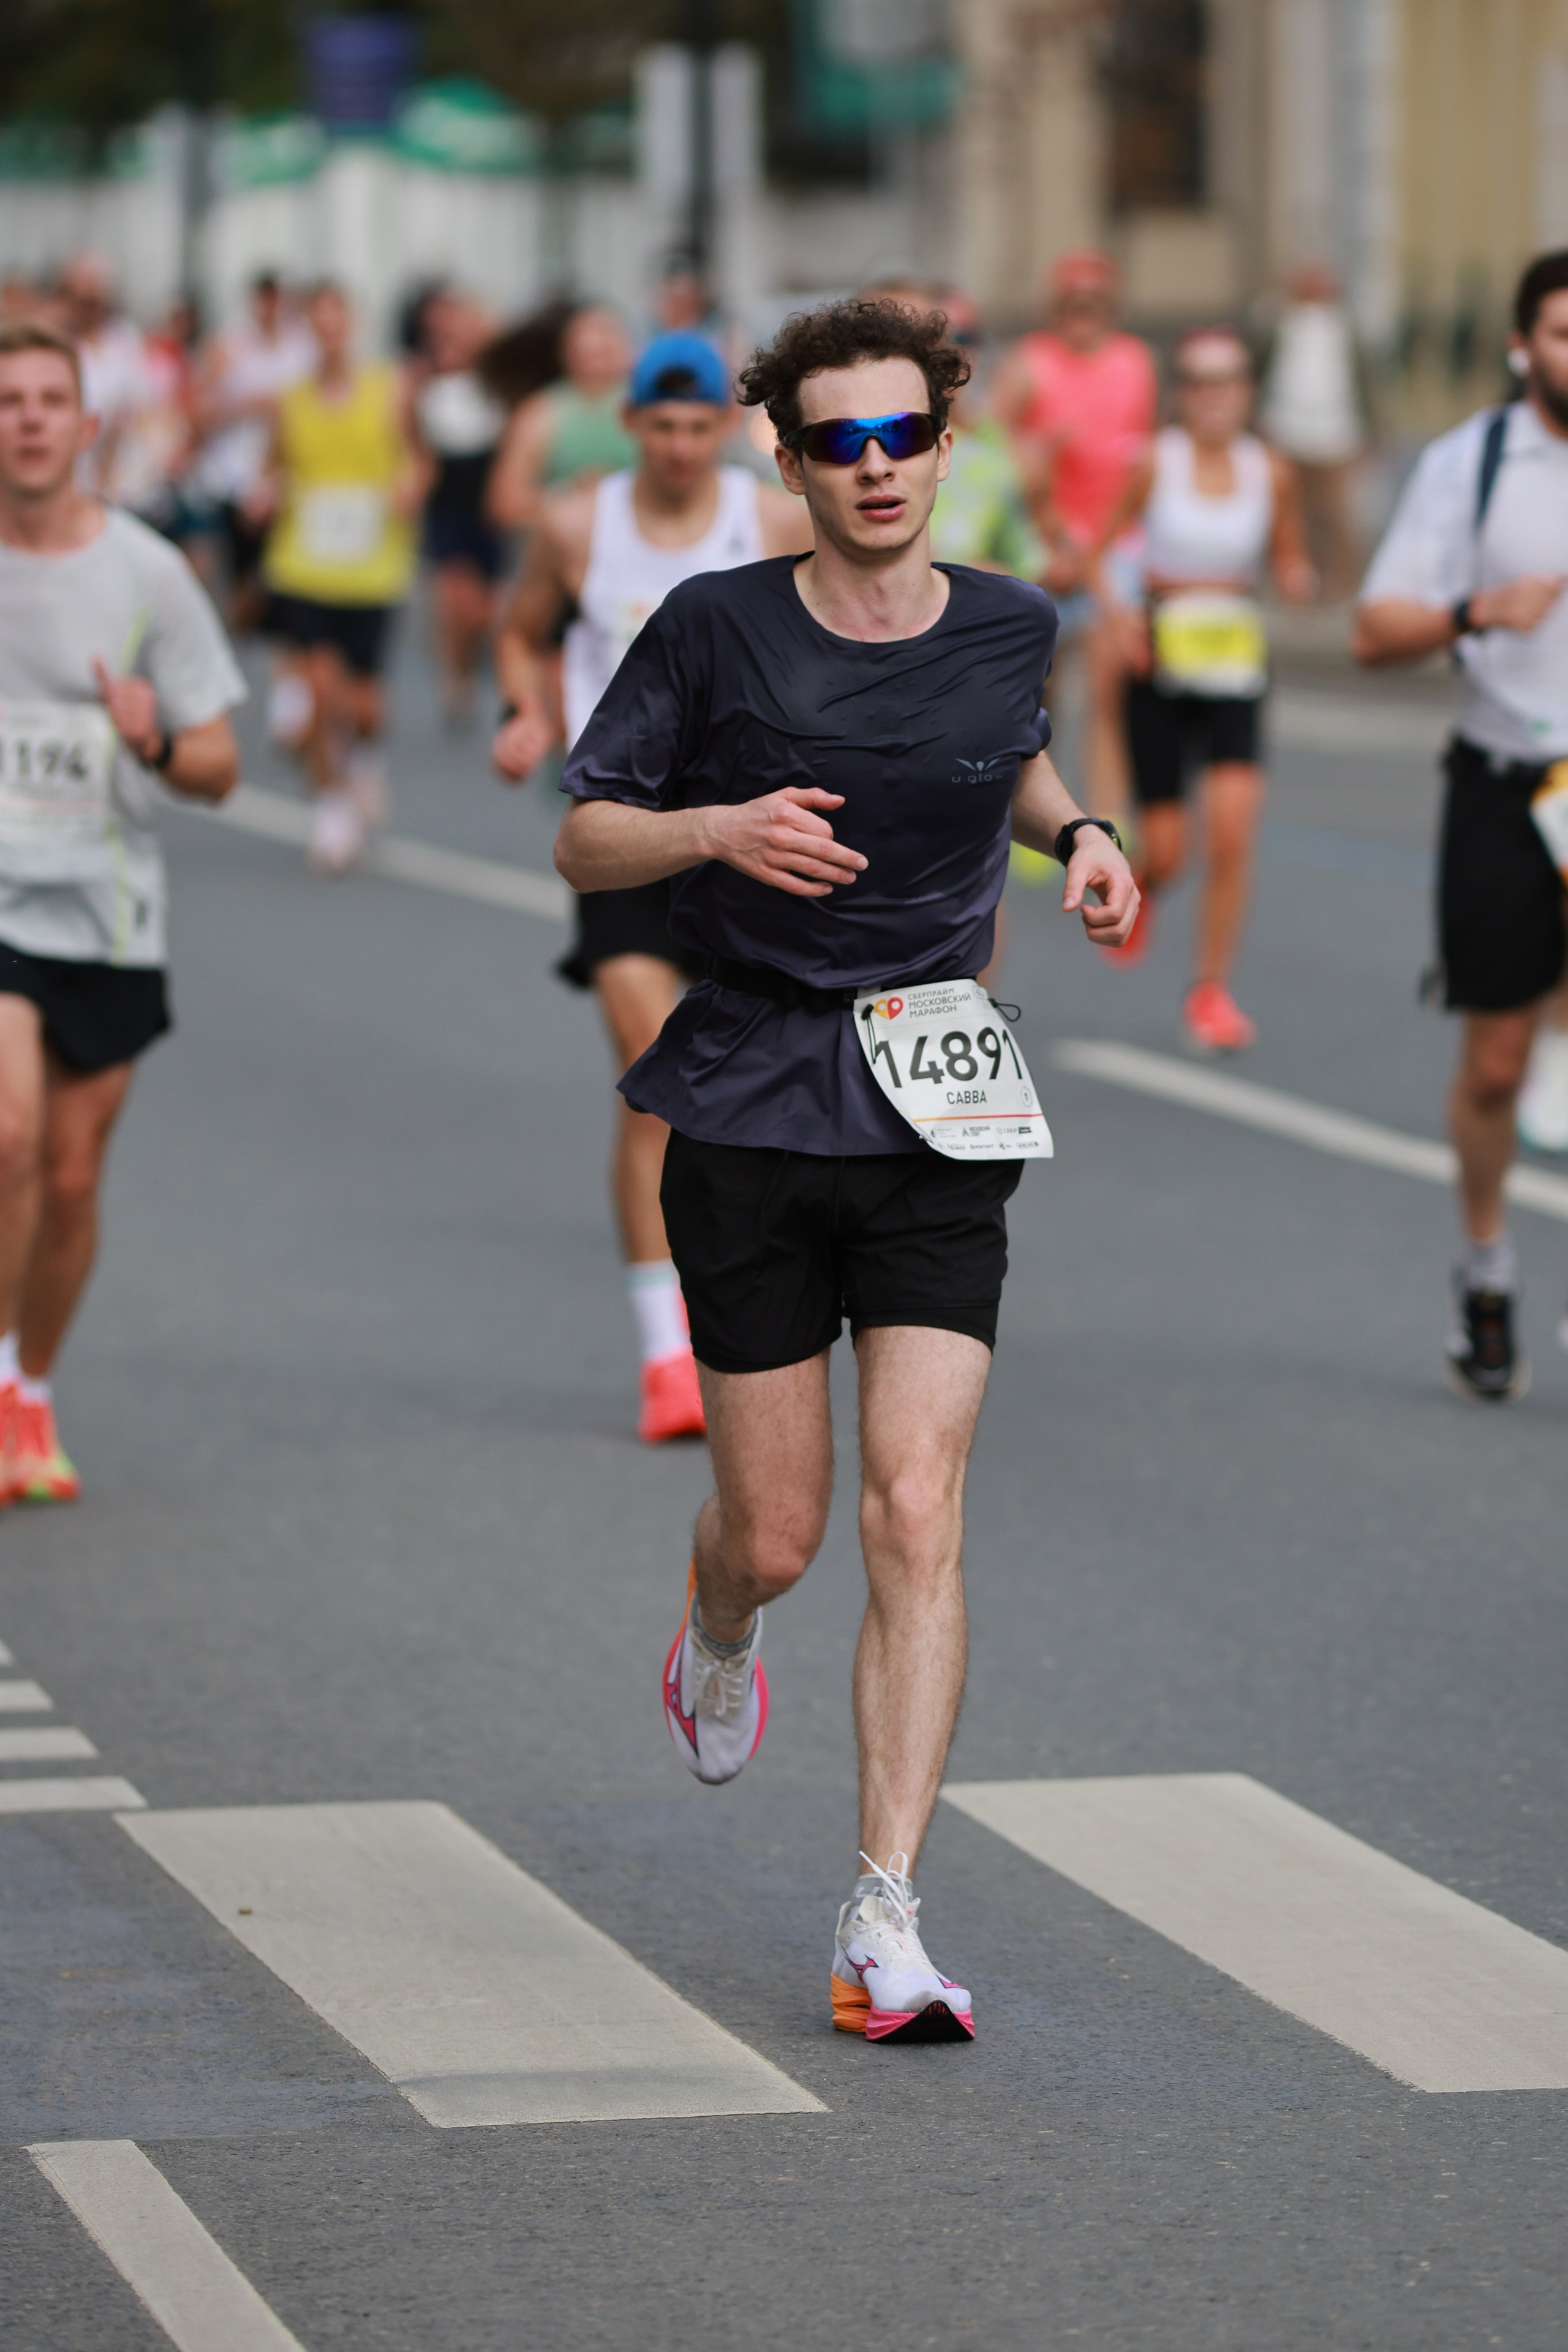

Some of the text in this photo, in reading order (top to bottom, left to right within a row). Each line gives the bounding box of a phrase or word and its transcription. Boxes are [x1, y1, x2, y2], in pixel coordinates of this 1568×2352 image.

[0, 739, 88, 780] 196
[908, 987, 954, 1000] СБЕРПРАЙМ
[909, 992, 971, 1009] МОСКОВСКИЙ
[910, 1005, 957, 1018] МАРАФОН
[875, 1027, 1022, 1088] 14891
[946, 1090, 987, 1104] САВВА
